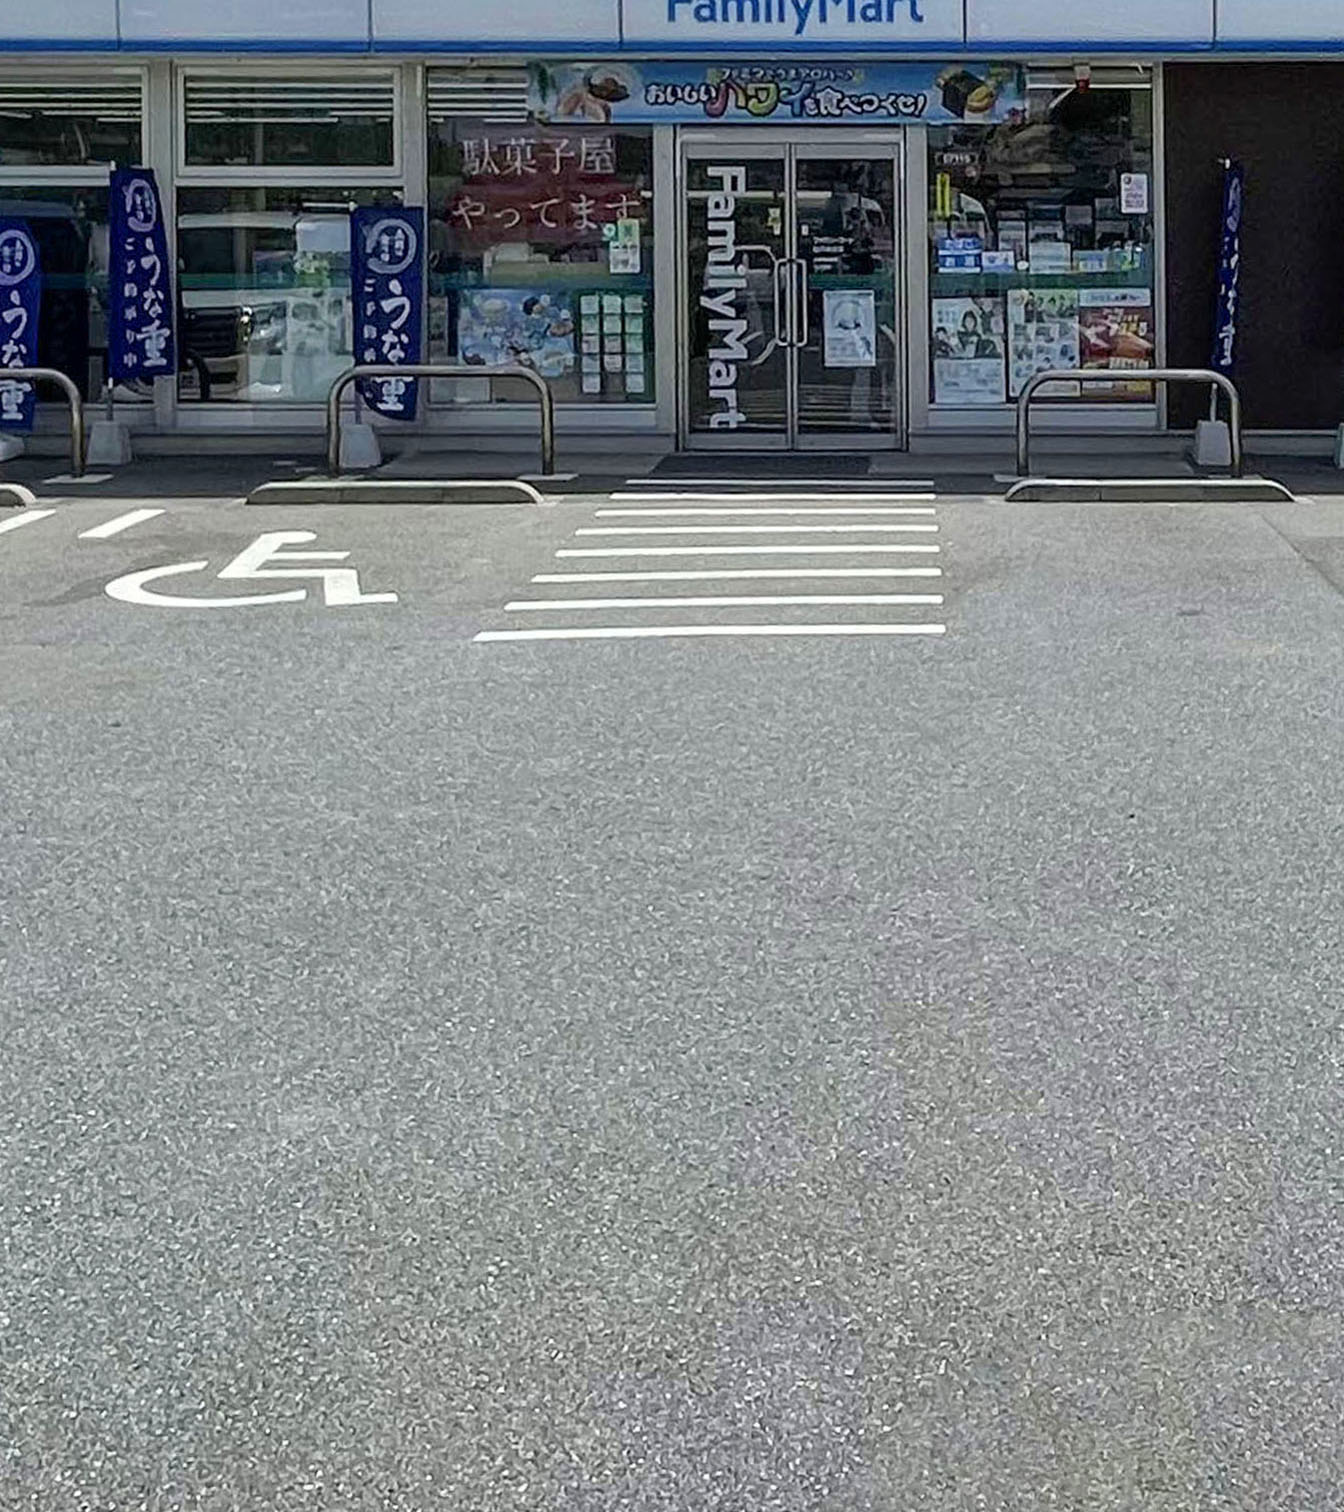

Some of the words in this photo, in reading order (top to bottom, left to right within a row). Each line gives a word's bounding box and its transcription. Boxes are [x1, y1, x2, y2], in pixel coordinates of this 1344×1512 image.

[463, 137, 616, 175] 駄菓子屋
[453, 194, 640, 229] やってます
[136, 237, 171, 367] うな重
[700, 166, 748, 428] FamilyMart
